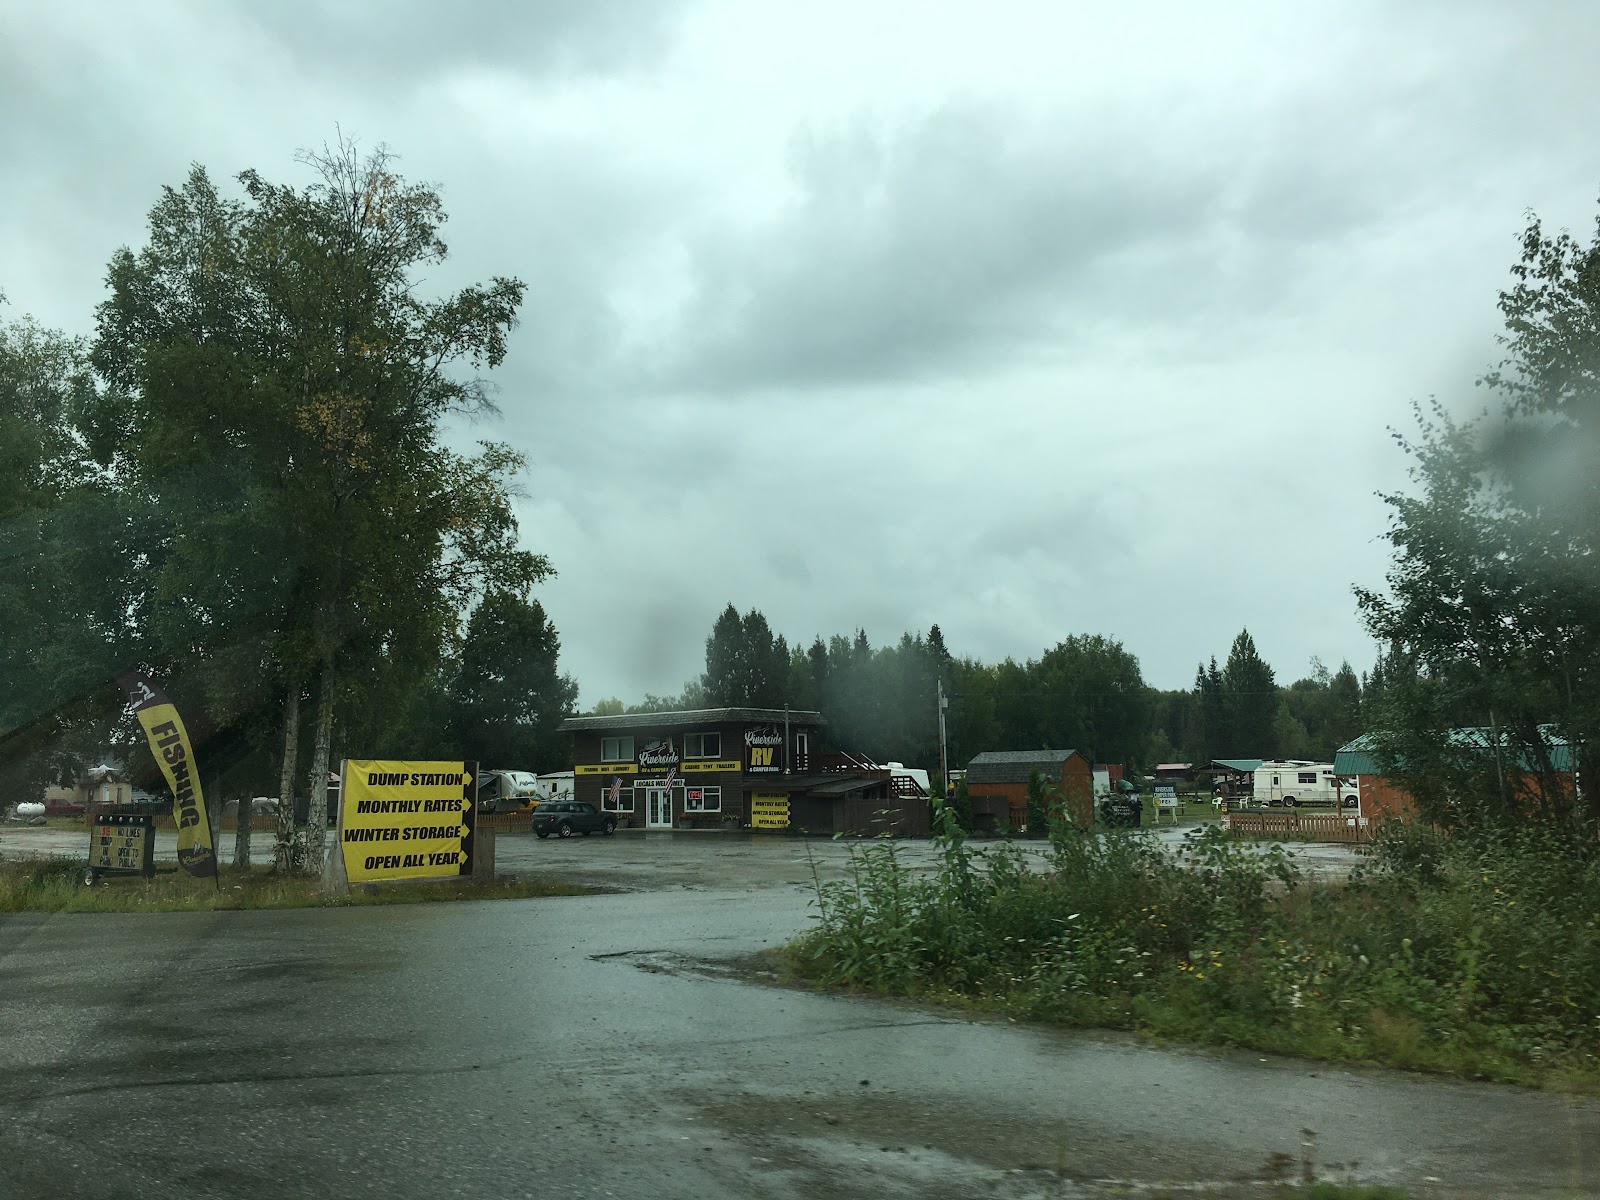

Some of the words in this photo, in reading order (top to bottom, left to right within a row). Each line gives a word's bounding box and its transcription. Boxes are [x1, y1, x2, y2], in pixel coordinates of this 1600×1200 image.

[745, 731, 783, 747] Riverside
[639, 751, 680, 767] Riverside
[751, 747, 774, 766] RV
[151, 720, 200, 830] FISHING
[368, 773, 408, 786] DUMP
[411, 773, 463, 786] STATION
[357, 800, 422, 813] MONTHLY
[424, 799, 462, 812] RATES
[344, 828, 400, 842] WINTER
[402, 826, 461, 840] STORAGE
[118, 848, 129, 857] OPEN
[132, 848, 138, 857] TO
[365, 856, 401, 870] OPEN
[403, 854, 424, 868] ALL
[428, 852, 460, 866] YEAR
